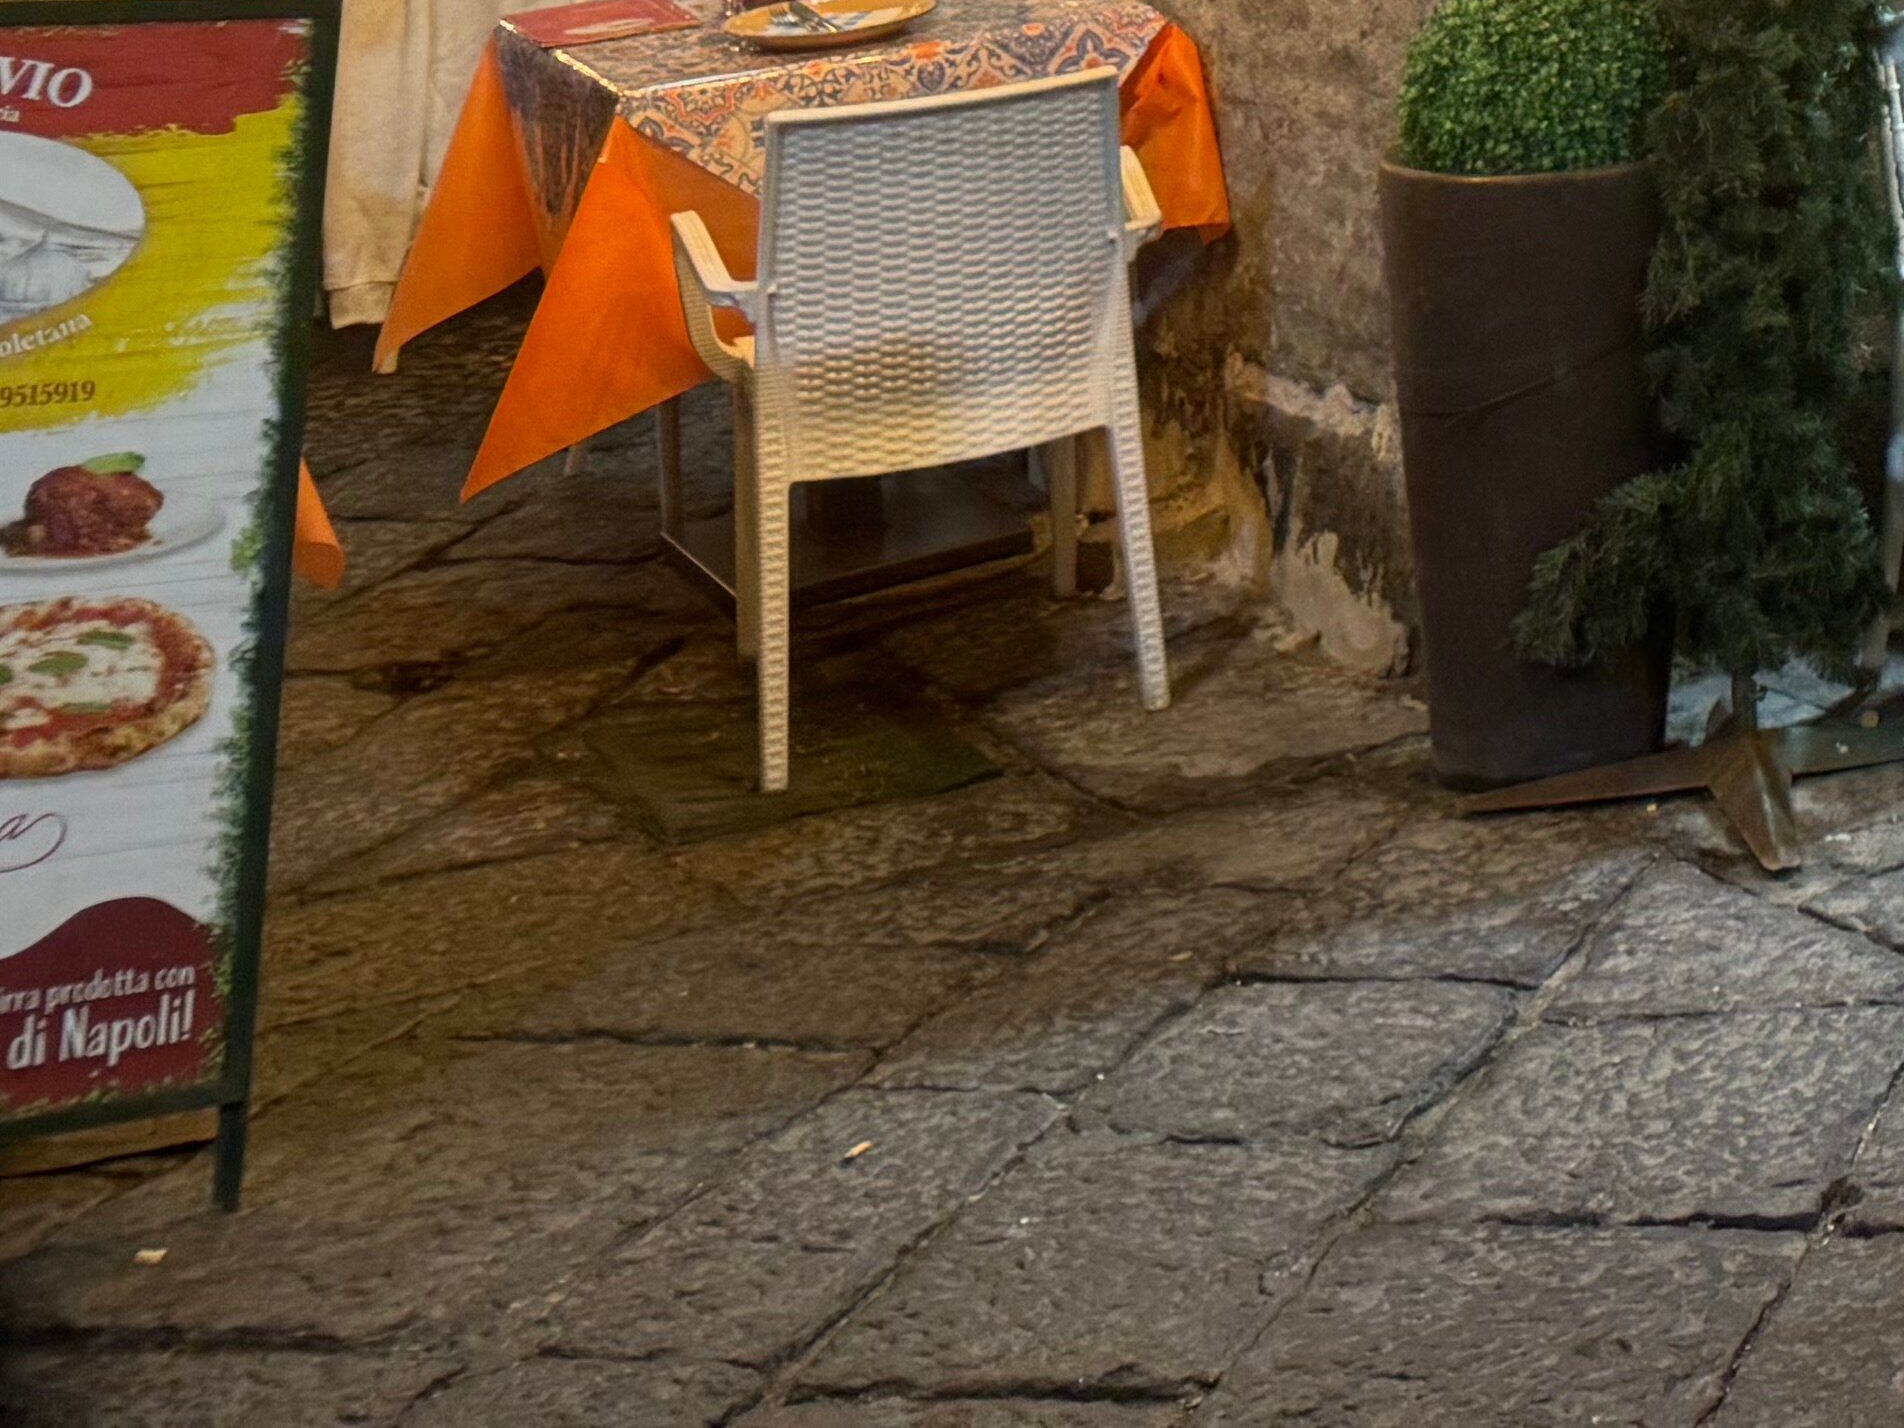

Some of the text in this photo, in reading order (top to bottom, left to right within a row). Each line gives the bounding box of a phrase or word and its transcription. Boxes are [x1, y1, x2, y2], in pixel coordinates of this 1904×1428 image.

[45, 968, 151, 1016] prodotta
[154, 966, 196, 991] con
[7, 989, 196, 1070] di Napoli!
